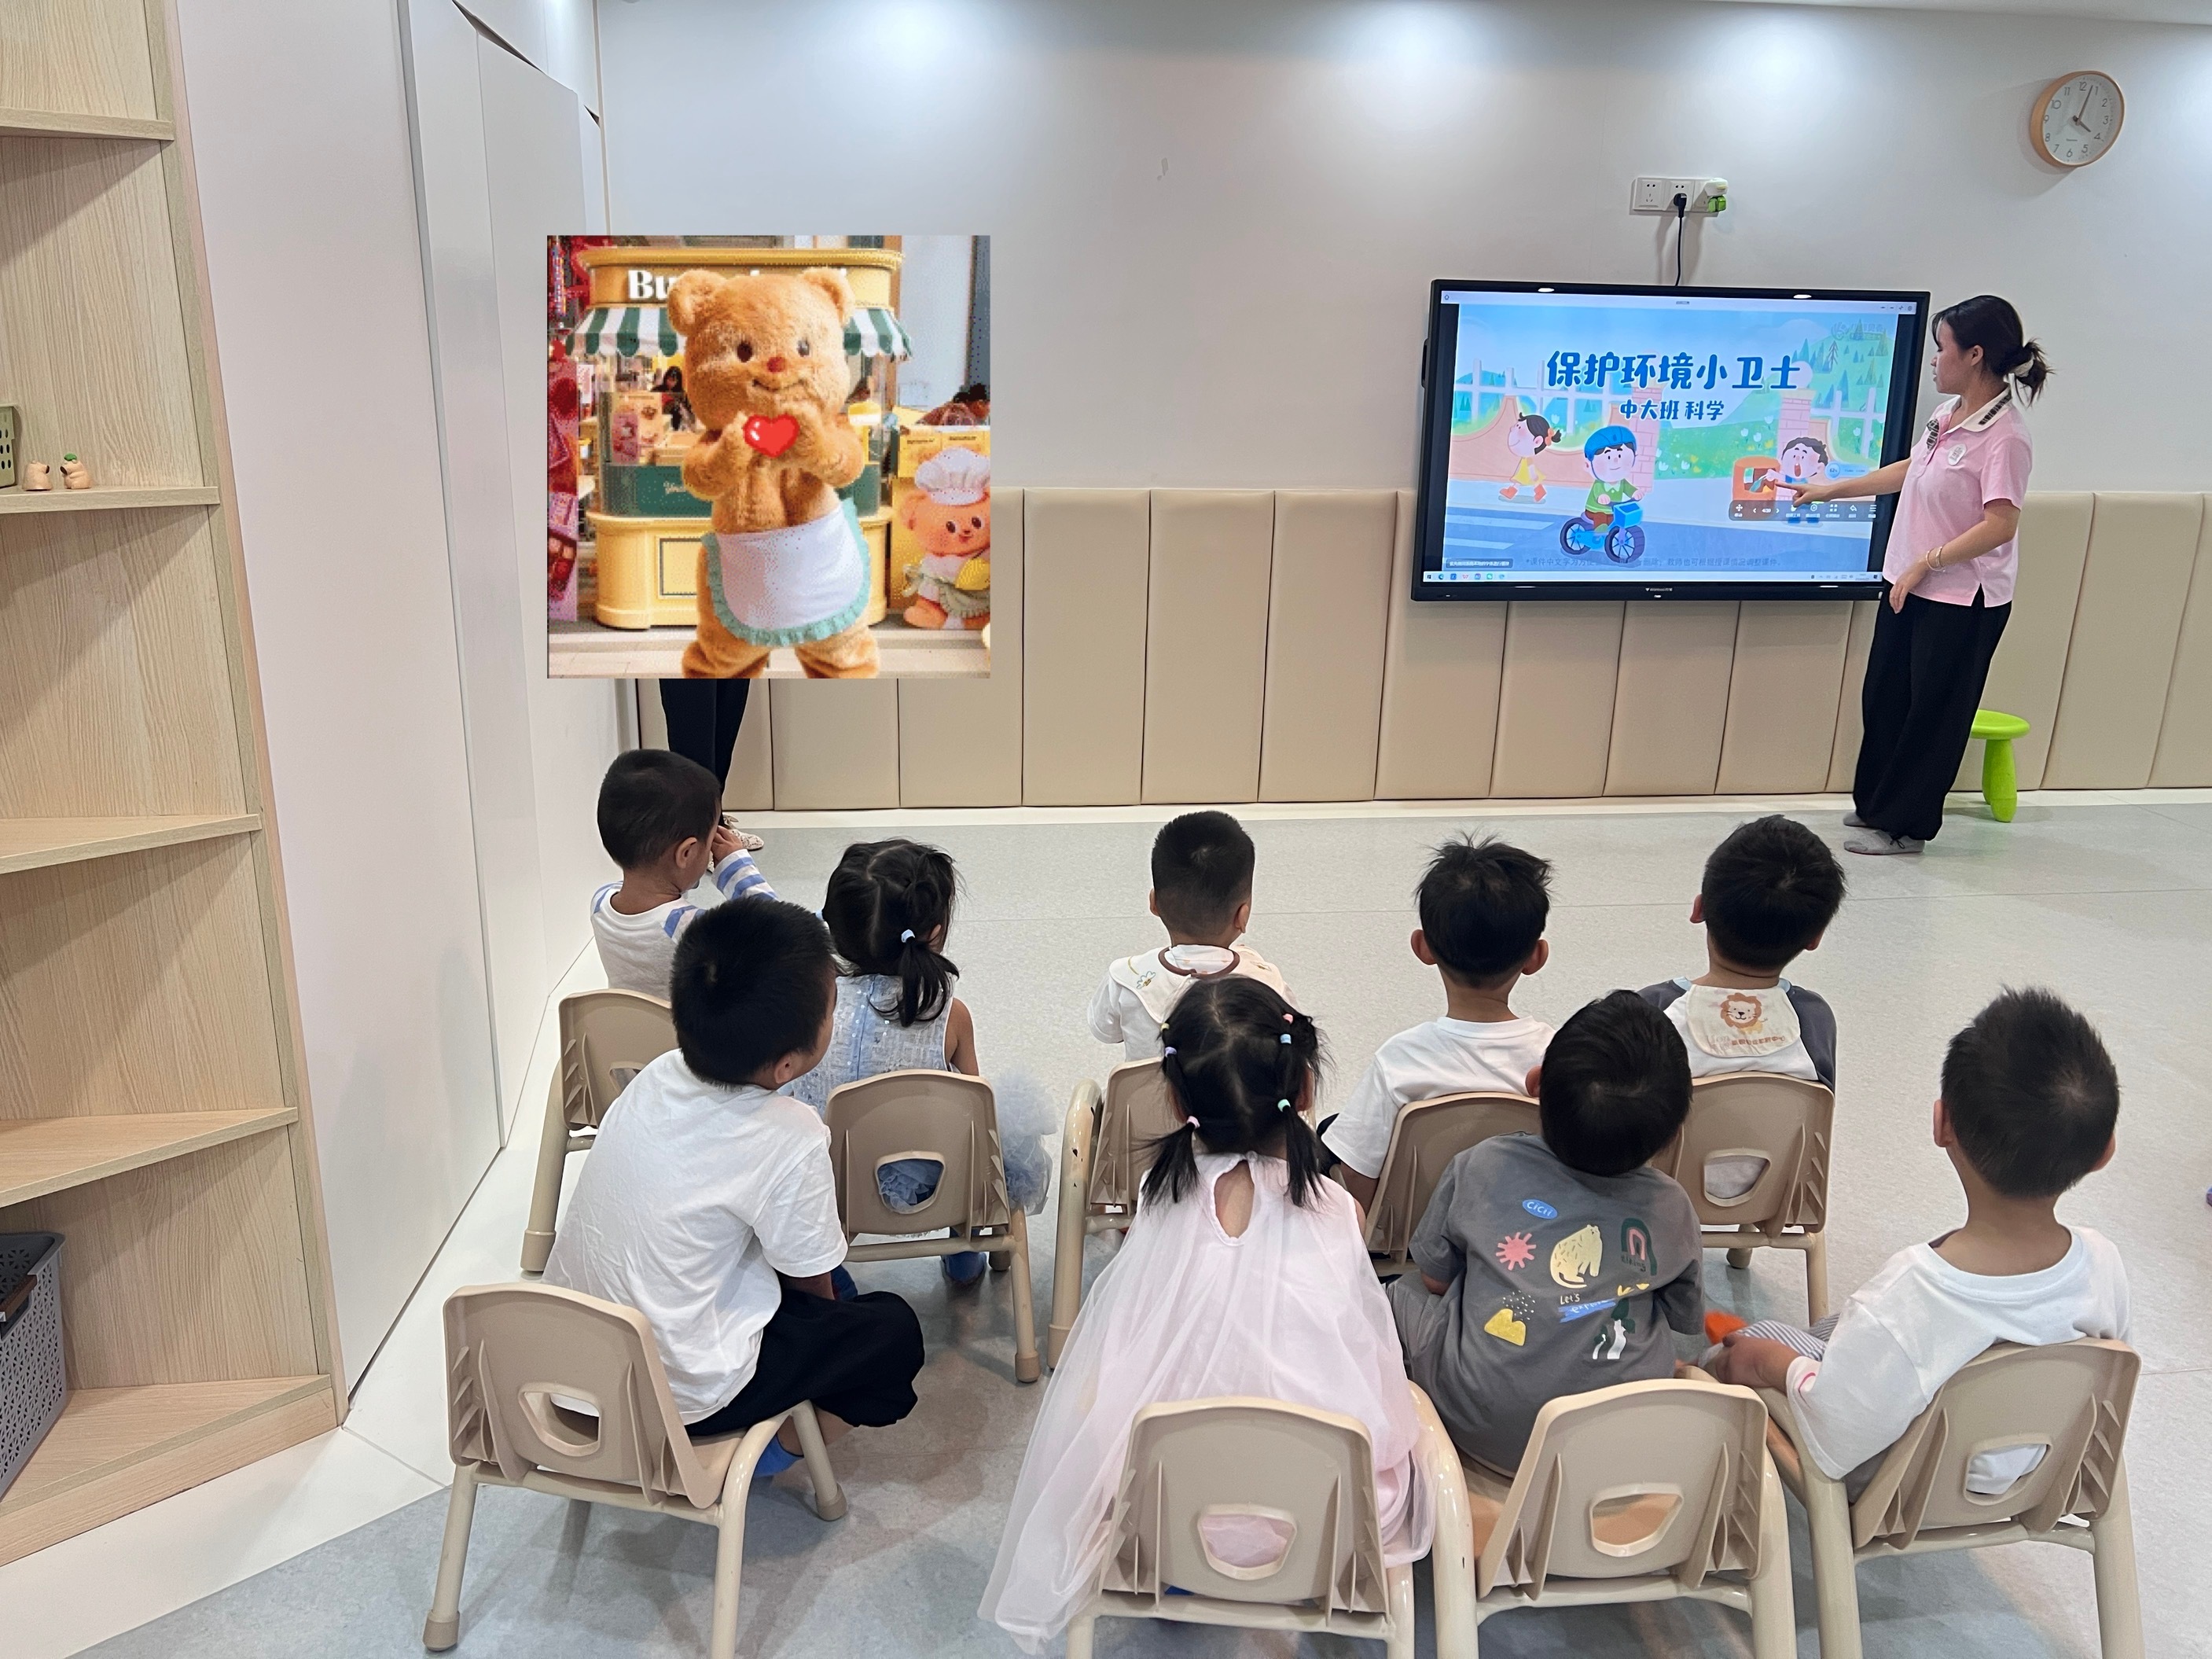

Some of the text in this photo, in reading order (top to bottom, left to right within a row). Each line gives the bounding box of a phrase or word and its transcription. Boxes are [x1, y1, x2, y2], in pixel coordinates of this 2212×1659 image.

[2063, 86, 2071, 96] 11
[2078, 81, 2088, 91] 12
[2050, 99, 2062, 110] 10
[2101, 98, 2108, 108] 2
[2043, 114, 2050, 124] 9
[2102, 115, 2109, 125] 3
[2045, 133, 2051, 142] 8
[2052, 144, 2060, 153] 7
[2066, 148, 2074, 158] 6
[2081, 144, 2089, 153] 5
[1547, 351, 1801, 390] 保护环境小卫士
[1620, 399, 1725, 421] 中大班 科学
